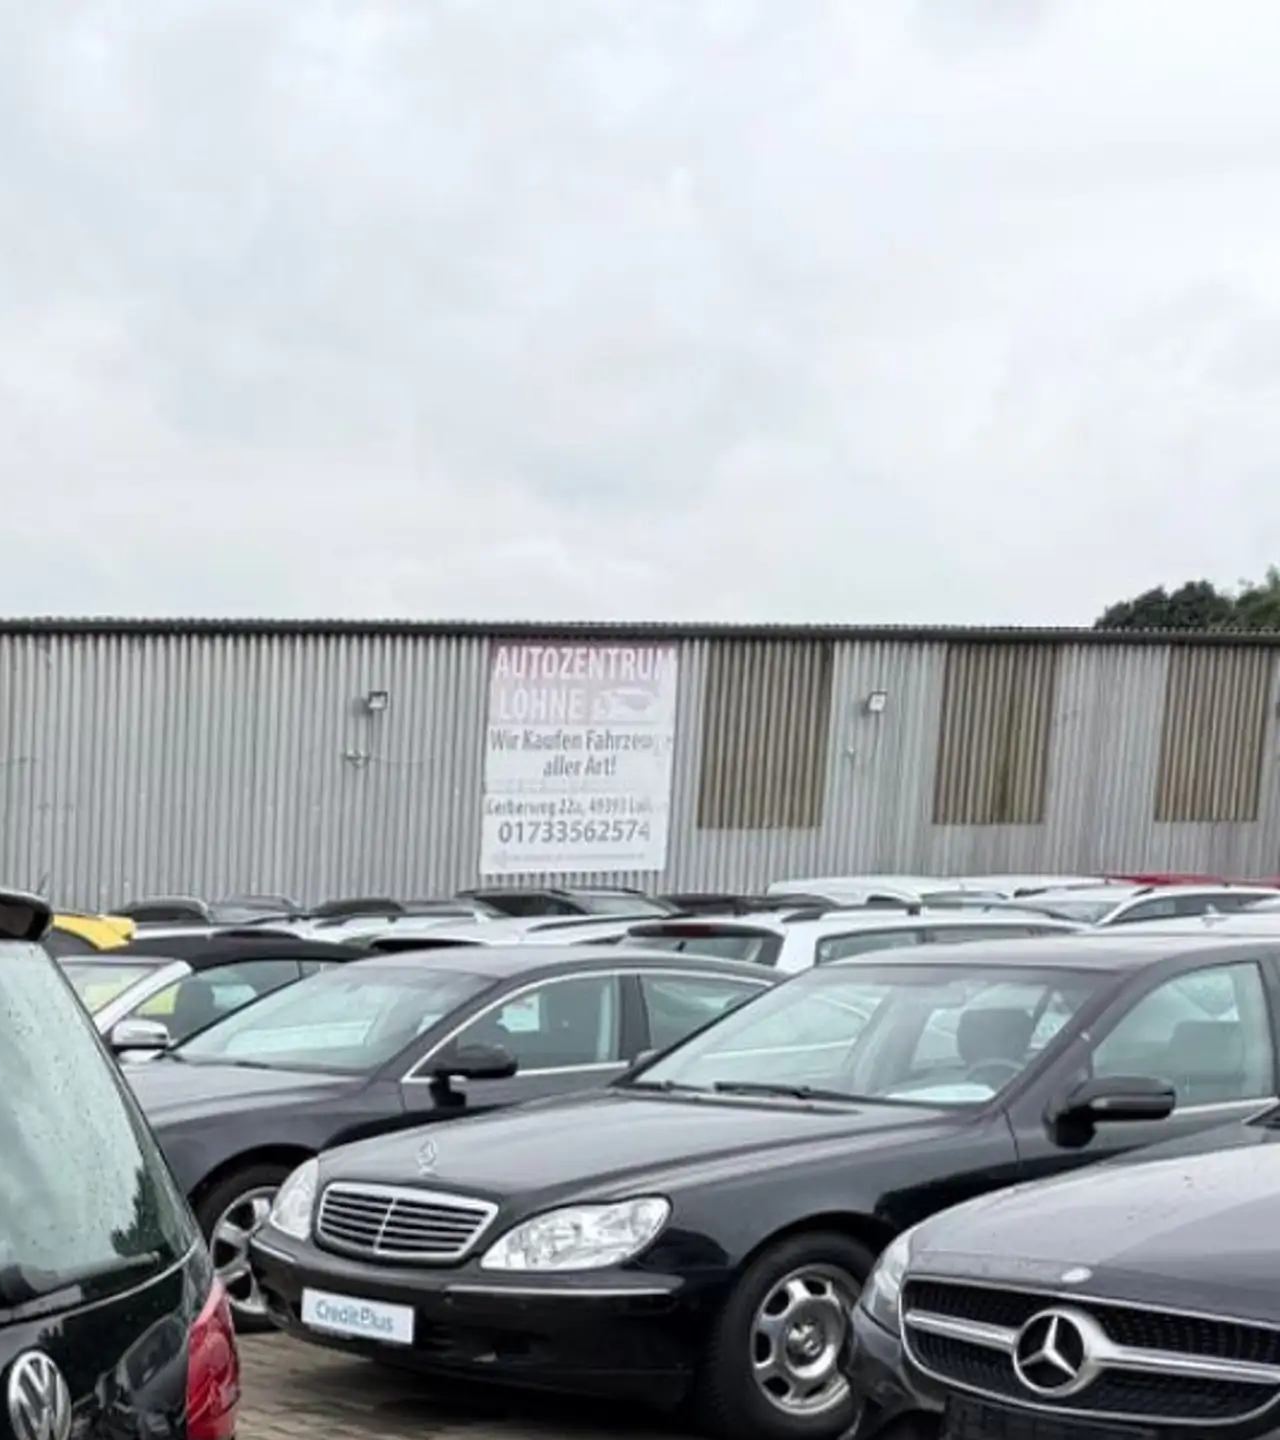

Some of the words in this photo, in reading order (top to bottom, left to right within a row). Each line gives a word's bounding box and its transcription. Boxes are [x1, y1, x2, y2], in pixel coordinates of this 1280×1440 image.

[494, 645, 676, 681] AUTOZENTRUM
[500, 686, 585, 721] LOHNE
[490, 730, 519, 750] Wir
[522, 729, 583, 751] Kaufen
[543, 755, 582, 777] aller
[584, 755, 616, 777] Art!
[498, 820, 650, 843] 01733562574
[315, 1299, 394, 1333] CreditPlus
